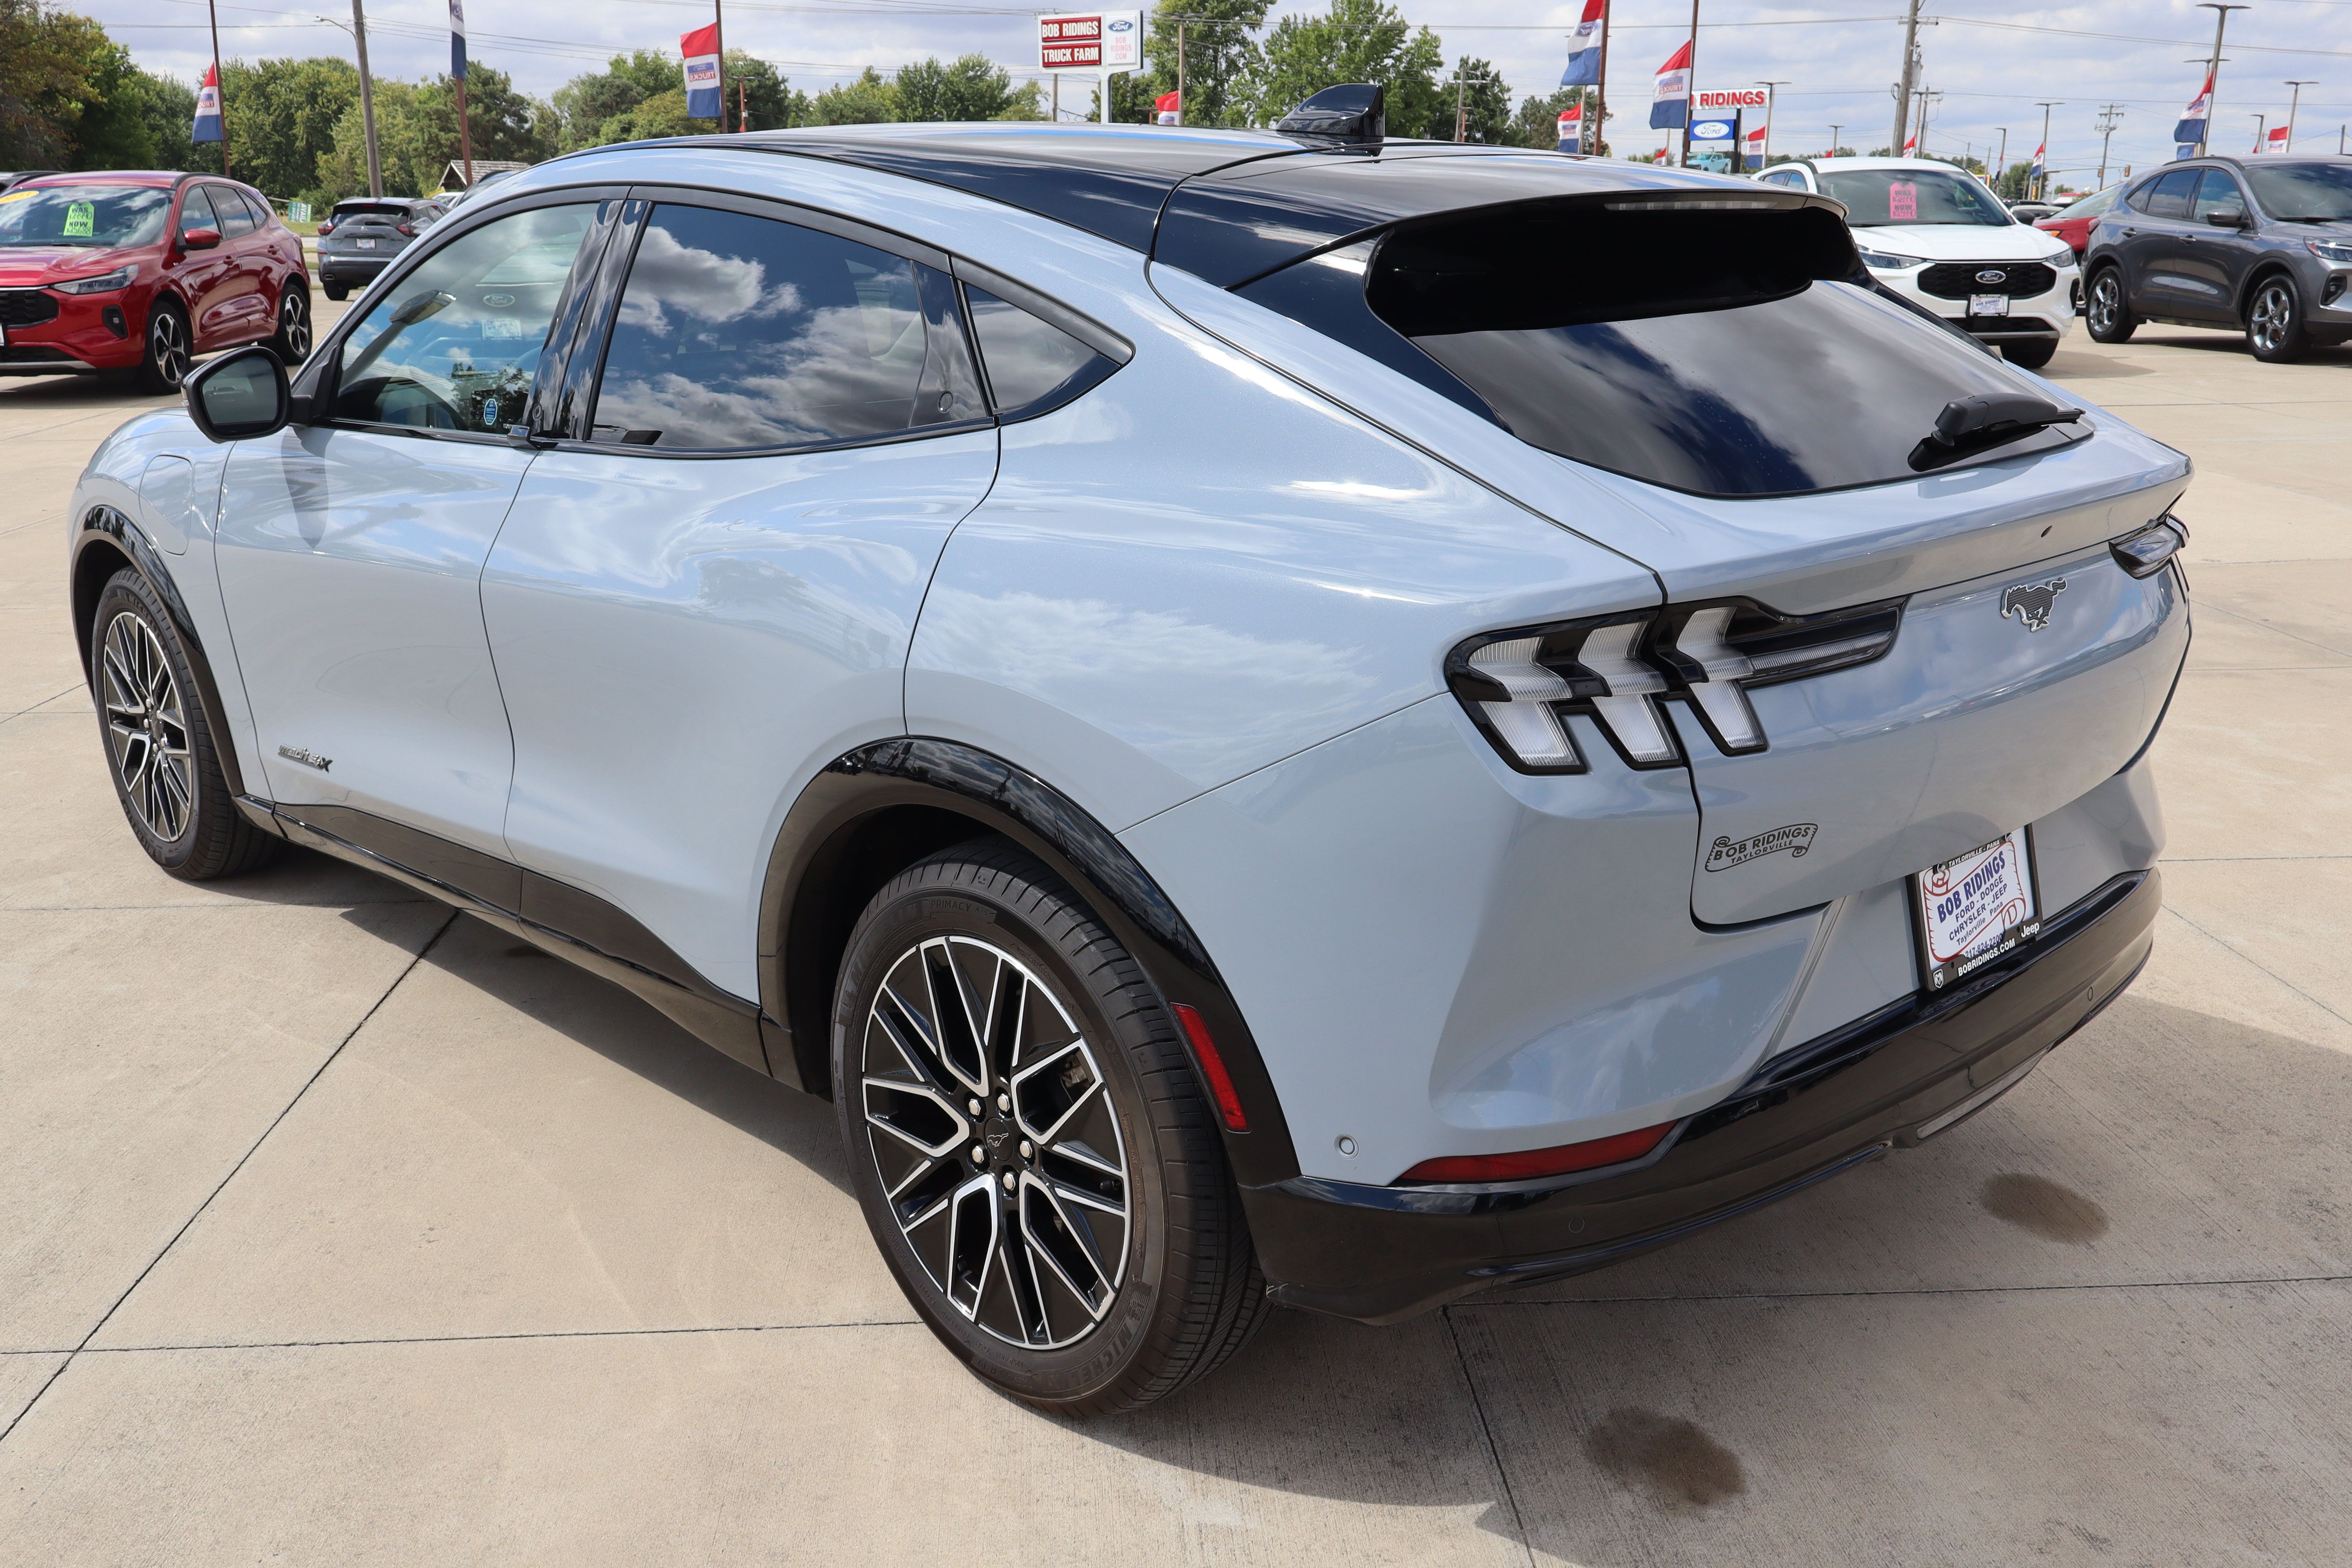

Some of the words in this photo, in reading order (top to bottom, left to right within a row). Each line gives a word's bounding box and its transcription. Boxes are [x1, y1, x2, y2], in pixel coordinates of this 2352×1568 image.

[1042, 24, 1060, 38] BOB
[1062, 21, 1099, 37] RIDINGS
[1043, 48, 1072, 62] TRUCK
[1074, 47, 1099, 61] FARM
[1700, 91, 1764, 106] RIDINGS
[1701, 124, 1722, 135] Ford
[1983, 272, 2000, 281] Ford
[1713, 843, 1747, 861] BOB
[1752, 826, 1811, 850] RIDINGS
[1731, 839, 1793, 864] TAYLORVILLE
[1948, 847, 1983, 868] TAYLORVILLE
[1987, 840, 2000, 851] PANA
[1937, 889, 1962, 924] BOB
[1963, 850, 2006, 900] RIDINGS
[930, 900, 971, 913] PRIMACY
[974, 906, 988, 916] A/S
[1955, 902, 1976, 923] FORD
[1980, 873, 2004, 900] DODGE
[1949, 904, 1986, 942] CHRYSLER
[1991, 883, 2008, 906] JEEP
[1956, 916, 1986, 946] Taylorville
[1989, 901, 2004, 917] Pana
[2020, 922, 2040, 940] Jeep
[1965, 933, 2003, 959] 217-824-2200
[1958, 938, 2016, 978] BOBRIDINGS.COM
[977, 1359, 987, 1369] 19
[990, 1366, 997, 1374] R
